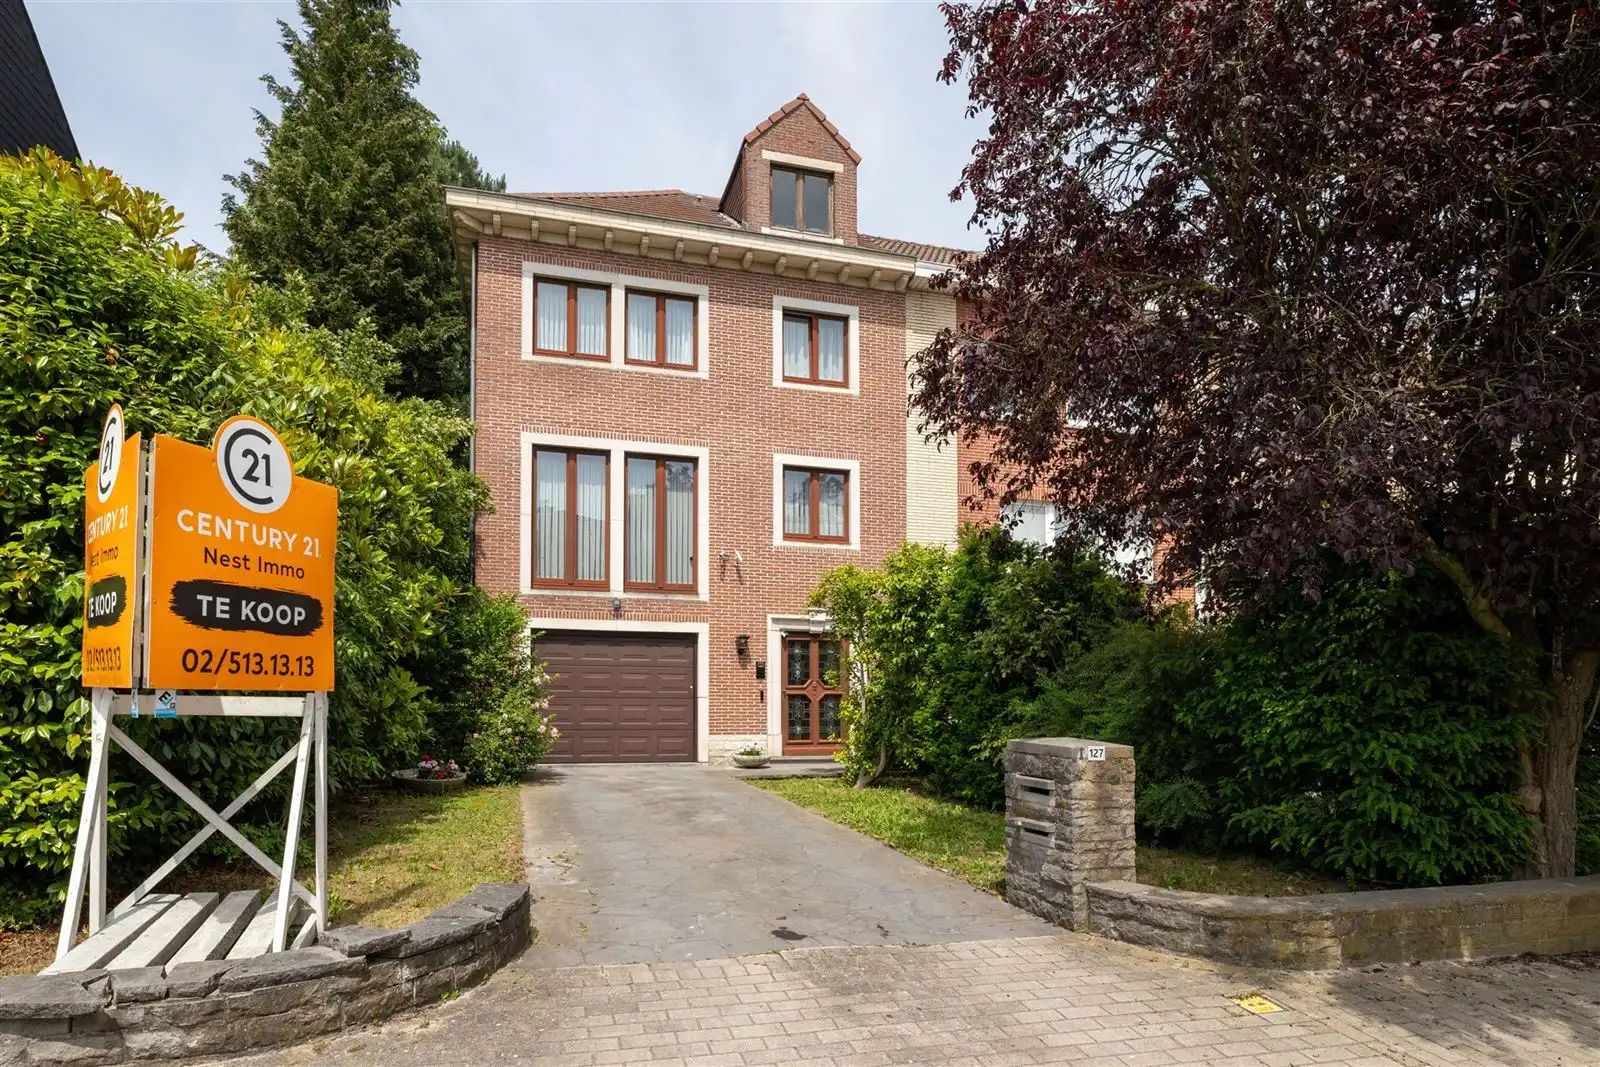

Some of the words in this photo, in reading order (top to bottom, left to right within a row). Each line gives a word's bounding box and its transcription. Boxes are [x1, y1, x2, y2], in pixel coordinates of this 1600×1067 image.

[102, 436, 114, 475] 21
[241, 448, 271, 487] 21
[88, 509, 119, 545] CENTURY
[119, 504, 128, 529] 21
[176, 509, 297, 552] CENTURY
[302, 536, 320, 558] 21
[203, 546, 251, 571] Nest
[258, 556, 305, 580] Immo
[88, 597, 94, 619] TE
[95, 591, 118, 617] KOOP
[196, 594, 230, 619] TE
[241, 599, 306, 626] KOOP
[181, 648, 315, 677] 02/513.13.13
[1089, 748, 1104, 758] 127
